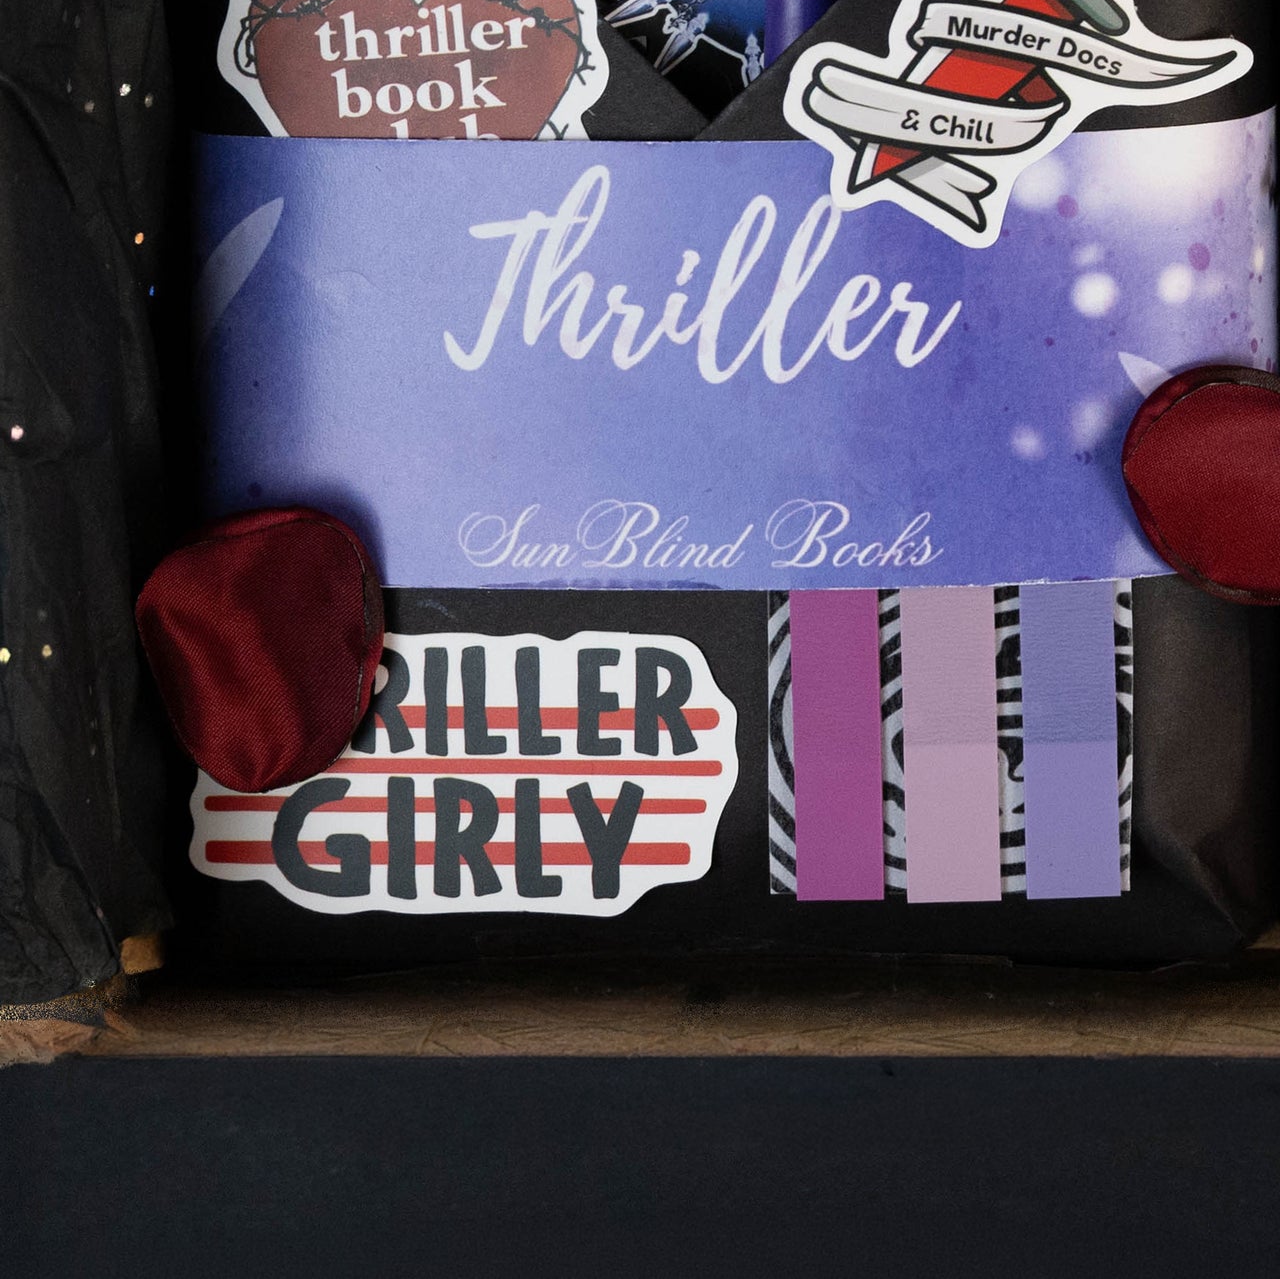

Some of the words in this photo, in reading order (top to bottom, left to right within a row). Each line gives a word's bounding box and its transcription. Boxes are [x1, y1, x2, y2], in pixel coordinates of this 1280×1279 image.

[314, 4, 535, 61] thriller
[947, 15, 1051, 52] Murder
[1056, 36, 1123, 76] Docs
[331, 59, 506, 118] book
[900, 108, 920, 131] &
[929, 113, 995, 144] Chill
[443, 164, 962, 385] Thriller
[457, 499, 747, 570] SunBlind
[763, 497, 944, 570] Books
[351, 646, 698, 756] RILLER
[270, 776, 645, 899] GIRLY
